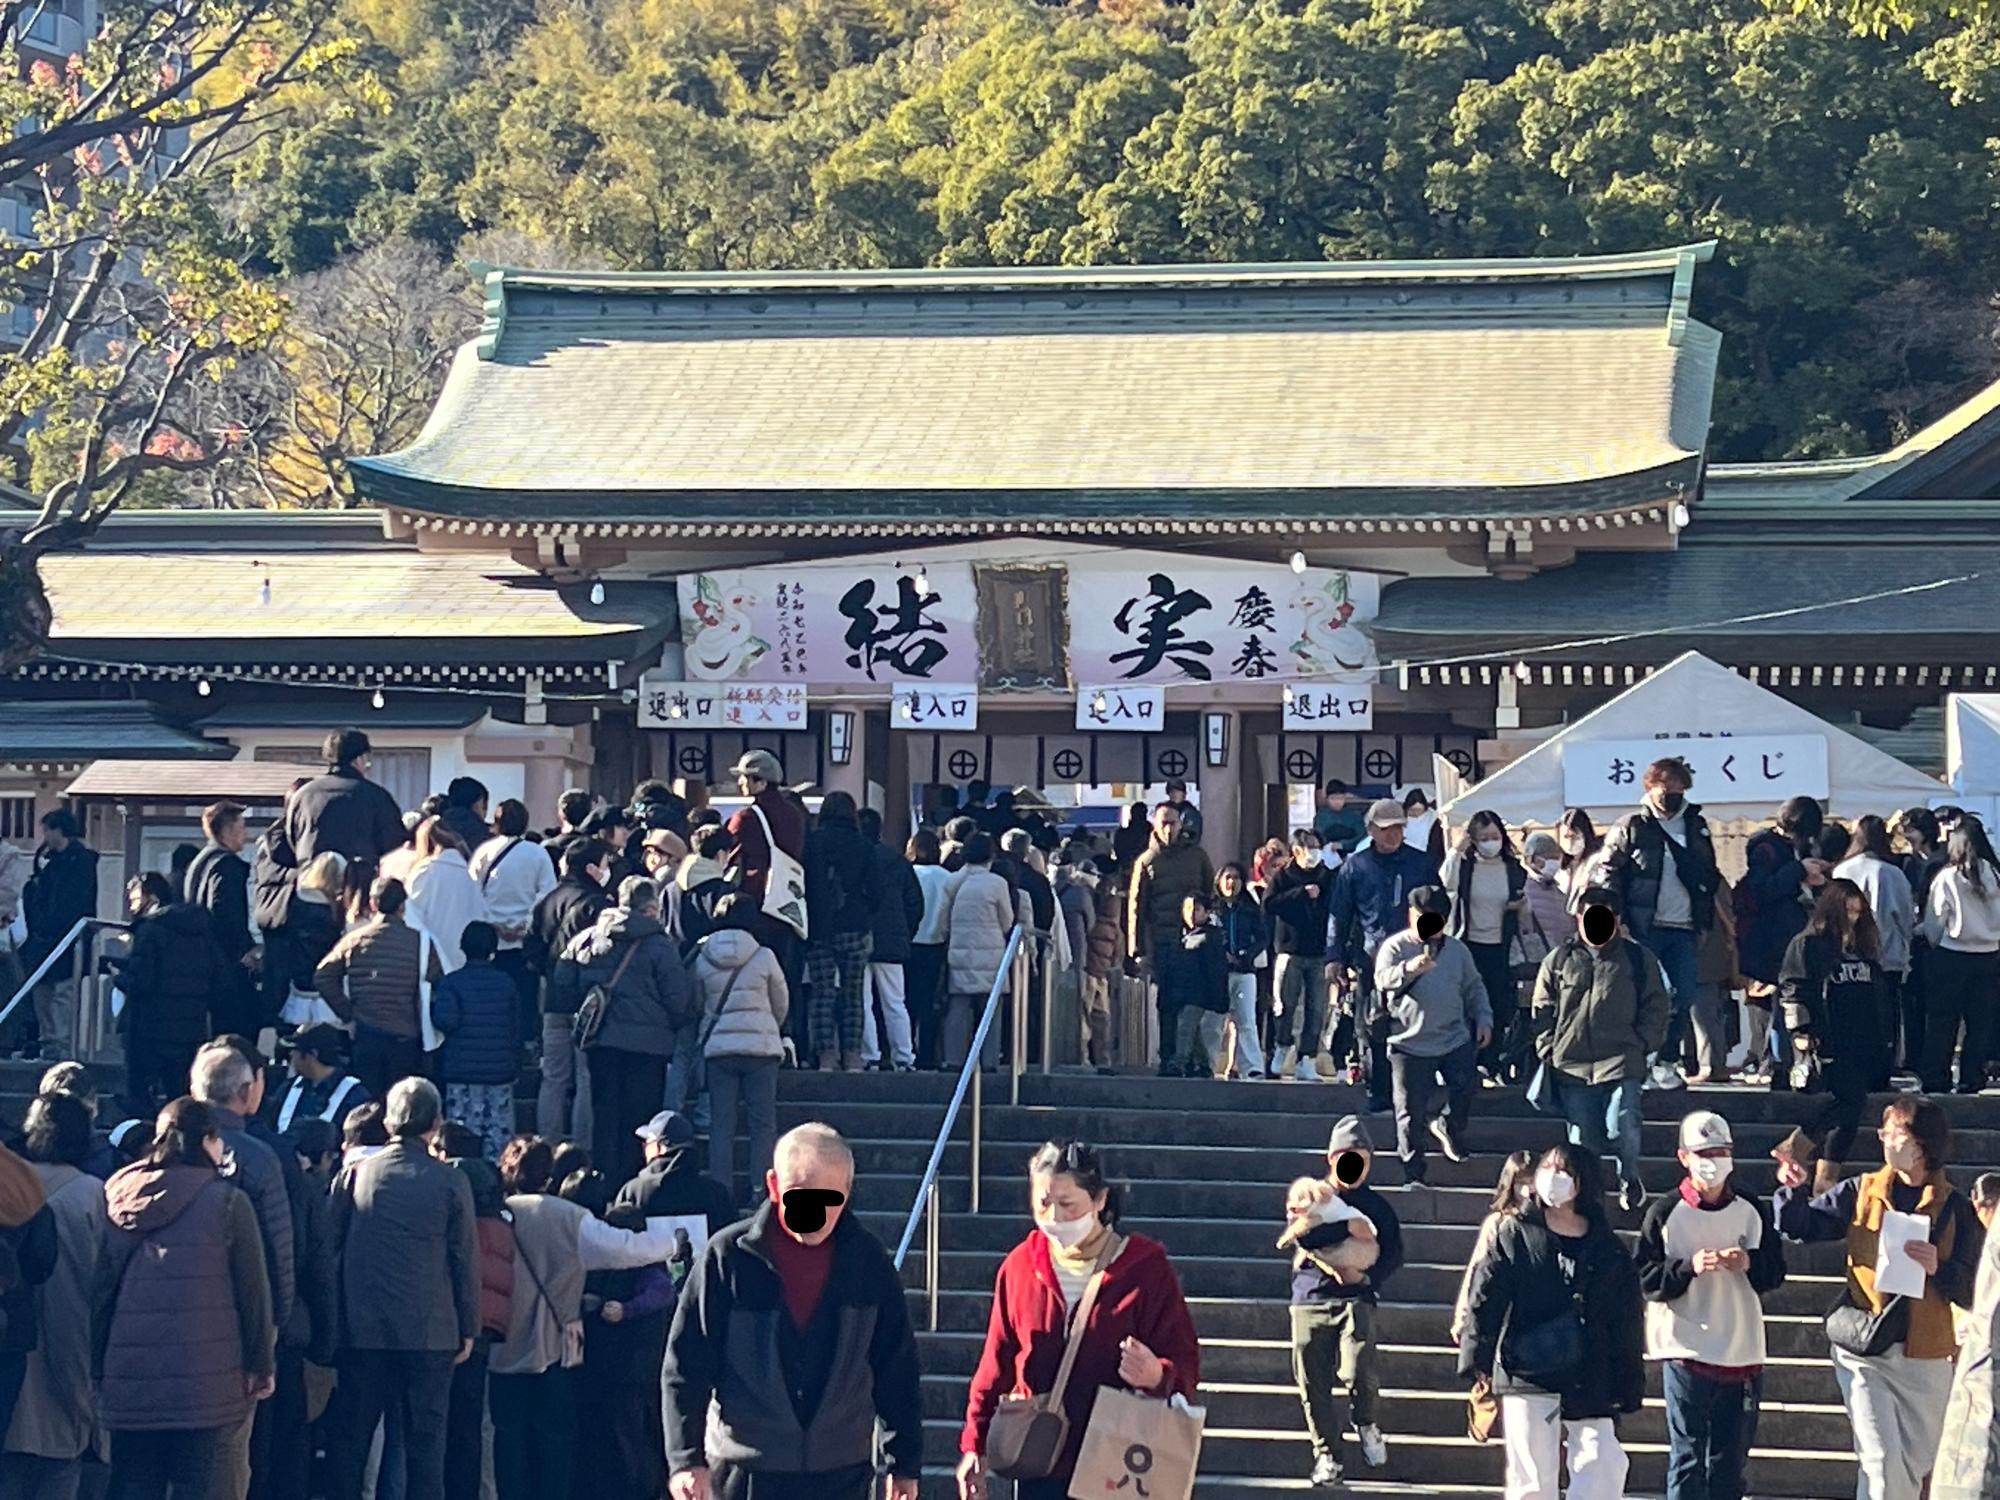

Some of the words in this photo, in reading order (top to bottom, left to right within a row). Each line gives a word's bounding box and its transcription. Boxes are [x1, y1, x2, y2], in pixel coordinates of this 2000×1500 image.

[839, 574, 949, 681] 結
[1108, 573, 1214, 680] 実
[1228, 585, 1278, 677] 慶春
[649, 691, 713, 721] 退出口
[1289, 693, 1369, 720] 退出口
[1608, 753, 1785, 785] おくじ
